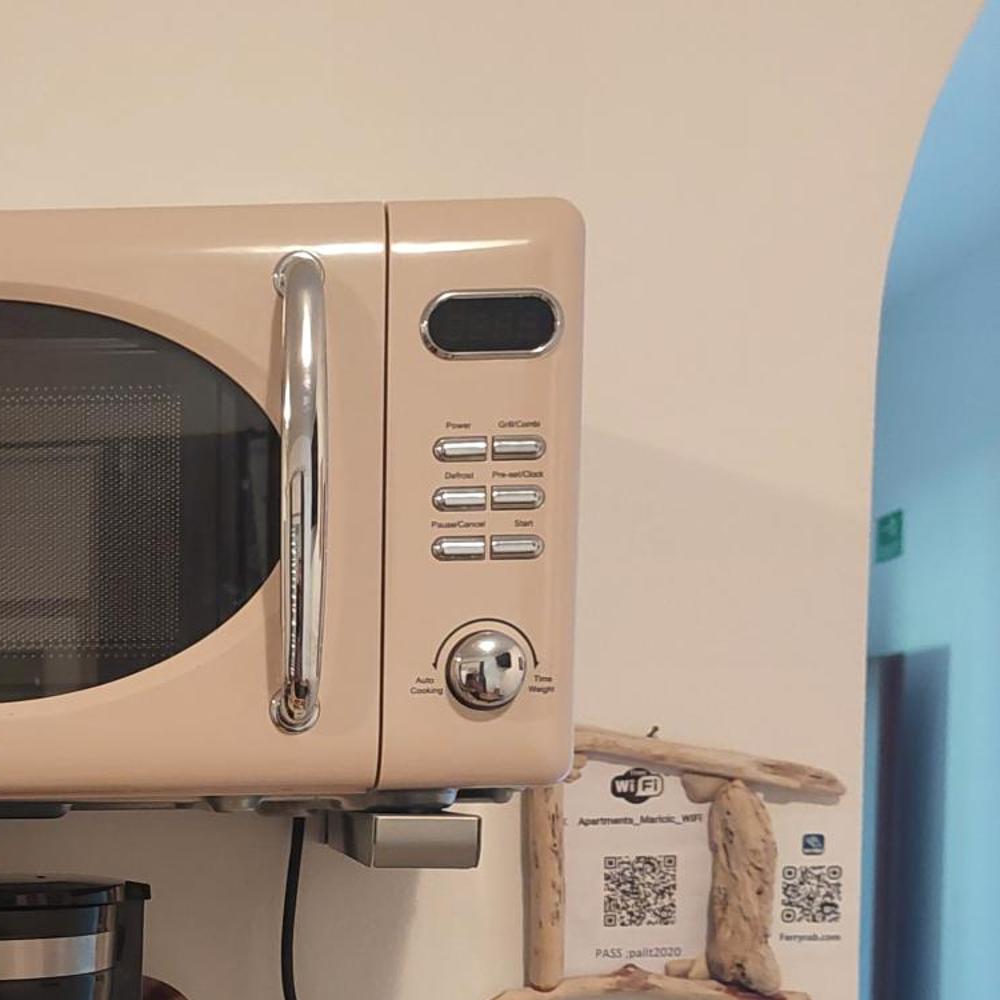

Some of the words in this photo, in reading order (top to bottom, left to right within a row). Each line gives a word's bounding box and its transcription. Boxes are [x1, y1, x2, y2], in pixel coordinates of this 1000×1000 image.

[444, 471, 474, 480] Defrost
[514, 519, 534, 528] Start
[595, 947, 622, 960] PASS
